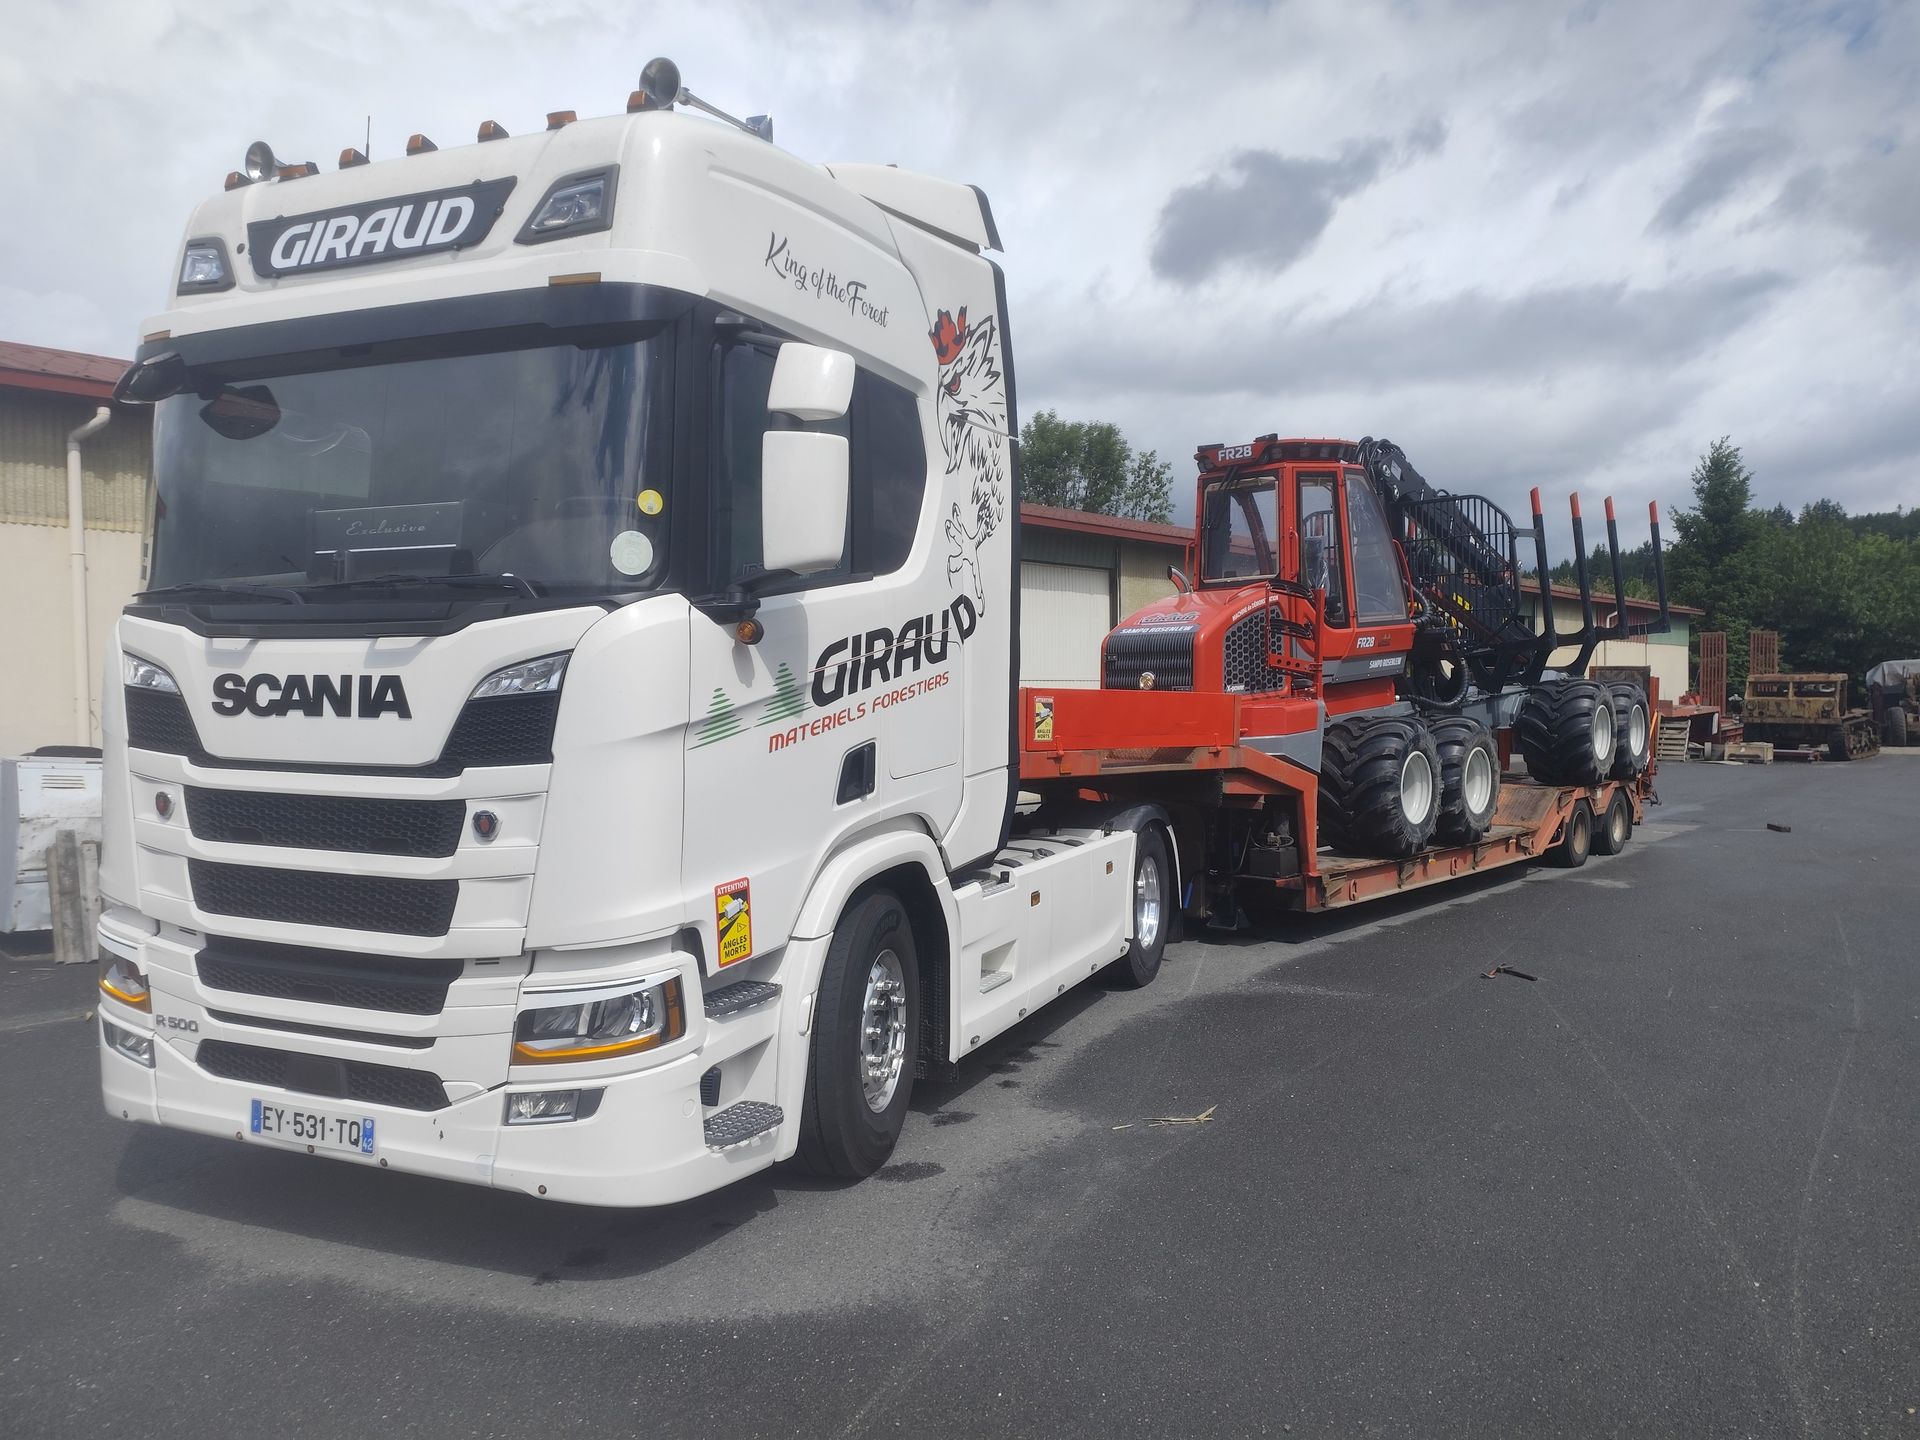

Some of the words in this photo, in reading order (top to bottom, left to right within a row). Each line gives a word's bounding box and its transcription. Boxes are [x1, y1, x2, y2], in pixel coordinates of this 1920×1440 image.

[270, 196, 475, 269] GIRAUD
[765, 231, 808, 291] King
[811, 268, 825, 299] of
[826, 272, 846, 303] the
[846, 280, 889, 328] Forest
[1218, 445, 1252, 461] FR28
[346, 519, 425, 536] Exclusive
[1149, 625, 1194, 633] ROSENLEW
[811, 594, 977, 707] GIRAUD
[1356, 636, 1375, 648] FR28
[211, 673, 412, 719] SCANIA
[768, 702, 866, 753] MATERIELS
[872, 671, 950, 713] FORESTIERS
[717, 880, 748, 895] ATTENTION
[723, 935, 747, 950] ANGLES
[724, 944, 747, 958] MORTS
[156, 1014, 166, 1027] R
[168, 1016, 199, 1032] 500
[262, 1106, 361, 1147] EY-531-TQ
[362, 1137, 373, 1151] 42
